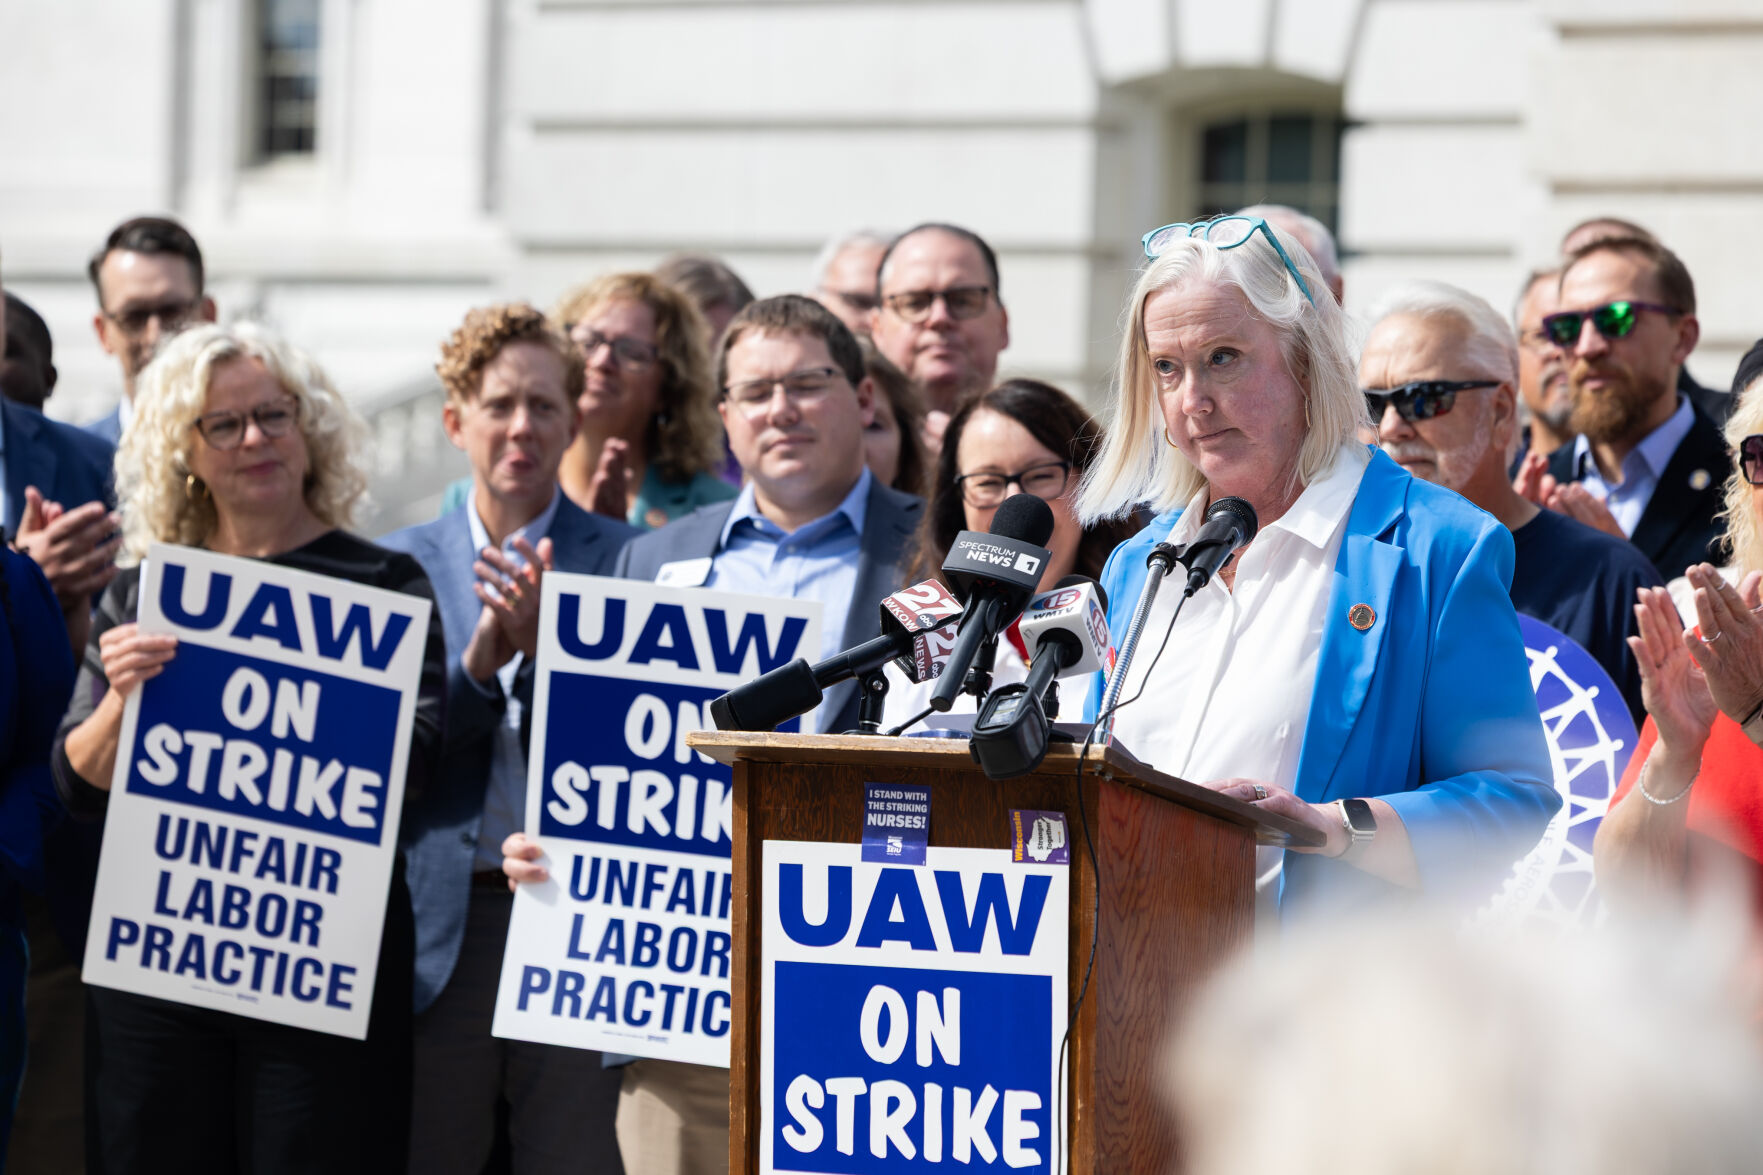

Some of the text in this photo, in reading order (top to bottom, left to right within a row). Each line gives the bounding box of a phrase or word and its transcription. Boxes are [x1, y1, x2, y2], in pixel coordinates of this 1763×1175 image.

[958, 540, 1016, 558] SPECTRUM
[966, 550, 1035, 573] NEWS 1
[158, 562, 413, 672] UAW
[885, 598, 918, 630] WKOW
[892, 585, 964, 616] 27
[919, 615, 933, 628] abc
[1033, 607, 1074, 620] WMTV
[1047, 590, 1078, 608] 15
[557, 592, 809, 675] UAW
[916, 638, 925, 680] NEWS
[221, 665, 321, 743] ON
[136, 722, 383, 829] STRIKE
[869, 790, 927, 801] I STAND WITH
[547, 760, 732, 843] STRIK
[867, 813, 927, 829] NURSES!
[868, 801, 928, 813] THE STRIKING
[154, 813, 342, 896] UNFAIR
[1013, 811, 1024, 862] Wisconsin
[1037, 821, 1045, 850] Stronger
[1046, 822, 1054, 850] Together
[153, 870, 324, 948] LABOR
[778, 862, 1053, 956] UAW
[105, 916, 357, 1011] PRACTICE
[566, 913, 732, 979] LABOR
[516, 965, 732, 1037] PRACTIC
[859, 984, 961, 1067] ON
[781, 1073, 1043, 1169] STRIKE
